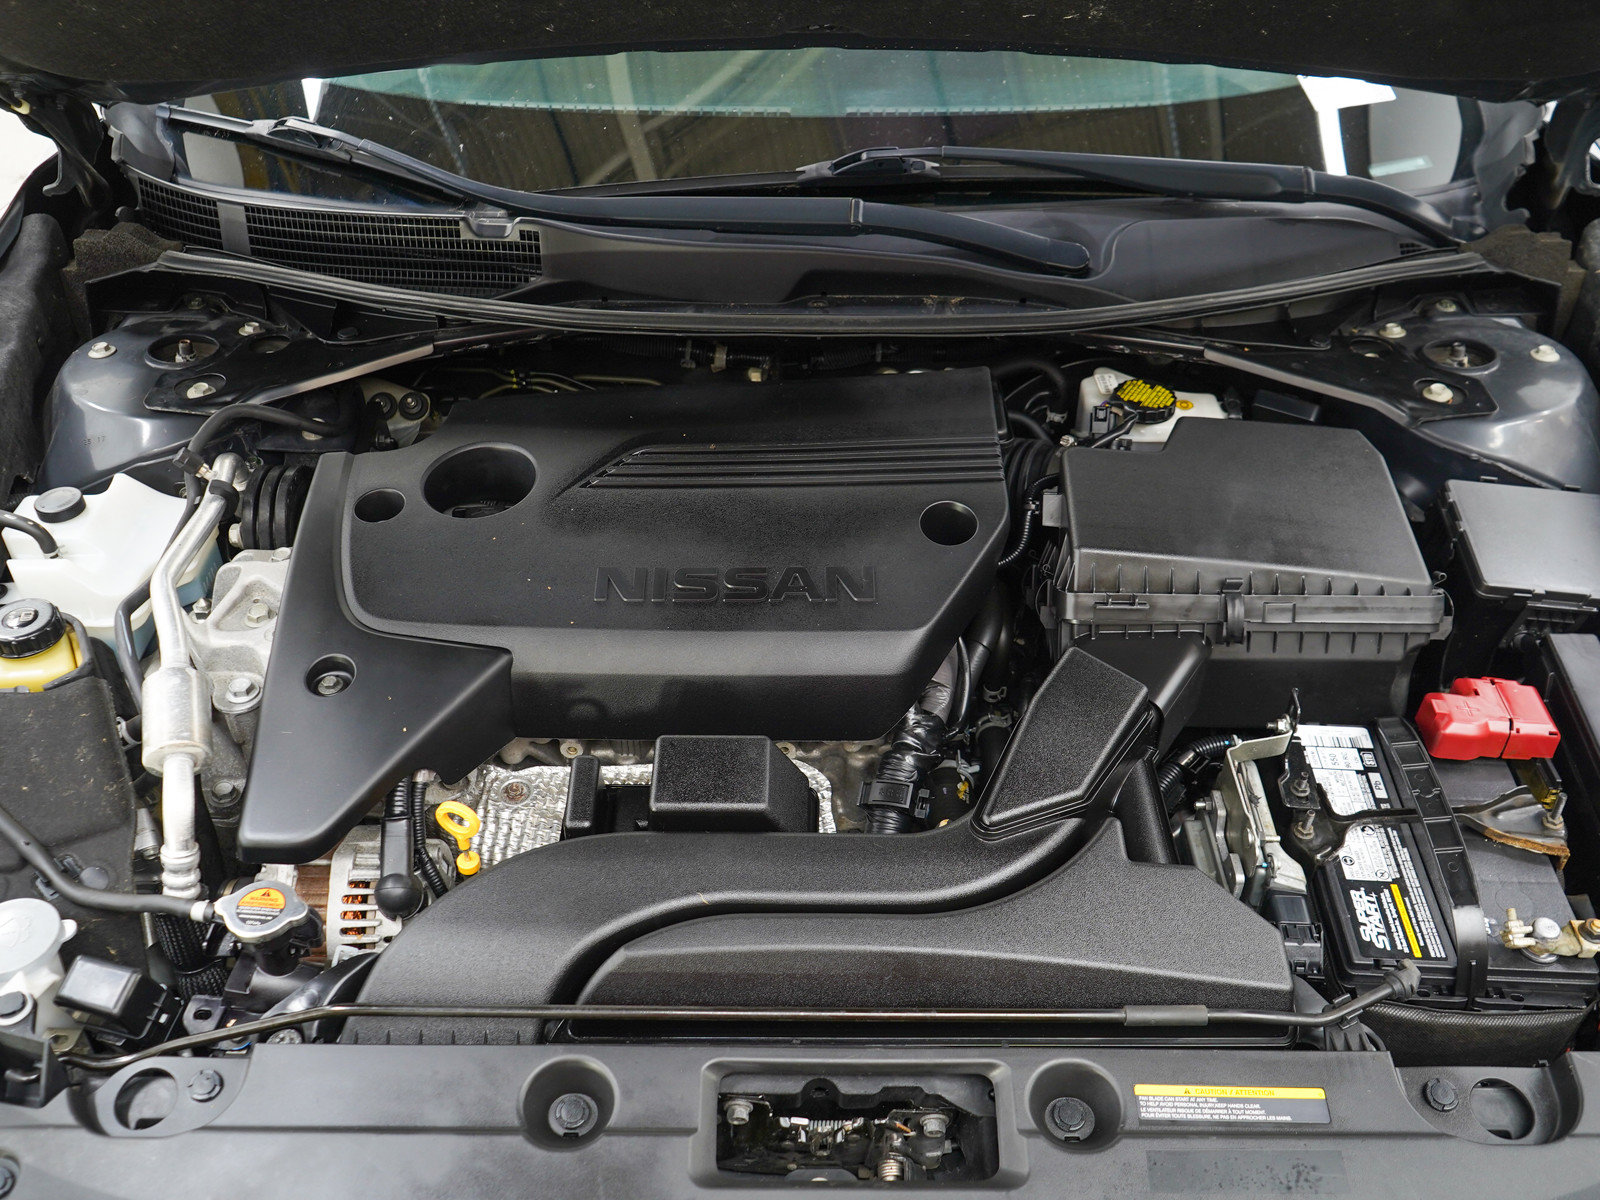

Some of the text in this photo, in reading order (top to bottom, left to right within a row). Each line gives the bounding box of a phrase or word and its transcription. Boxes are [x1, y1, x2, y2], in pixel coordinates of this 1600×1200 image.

[593, 565, 876, 602] NISSAN
[1373, 780, 1383, 791] Pb
[1349, 889, 1372, 942] SUPER
[1363, 888, 1391, 951] START
